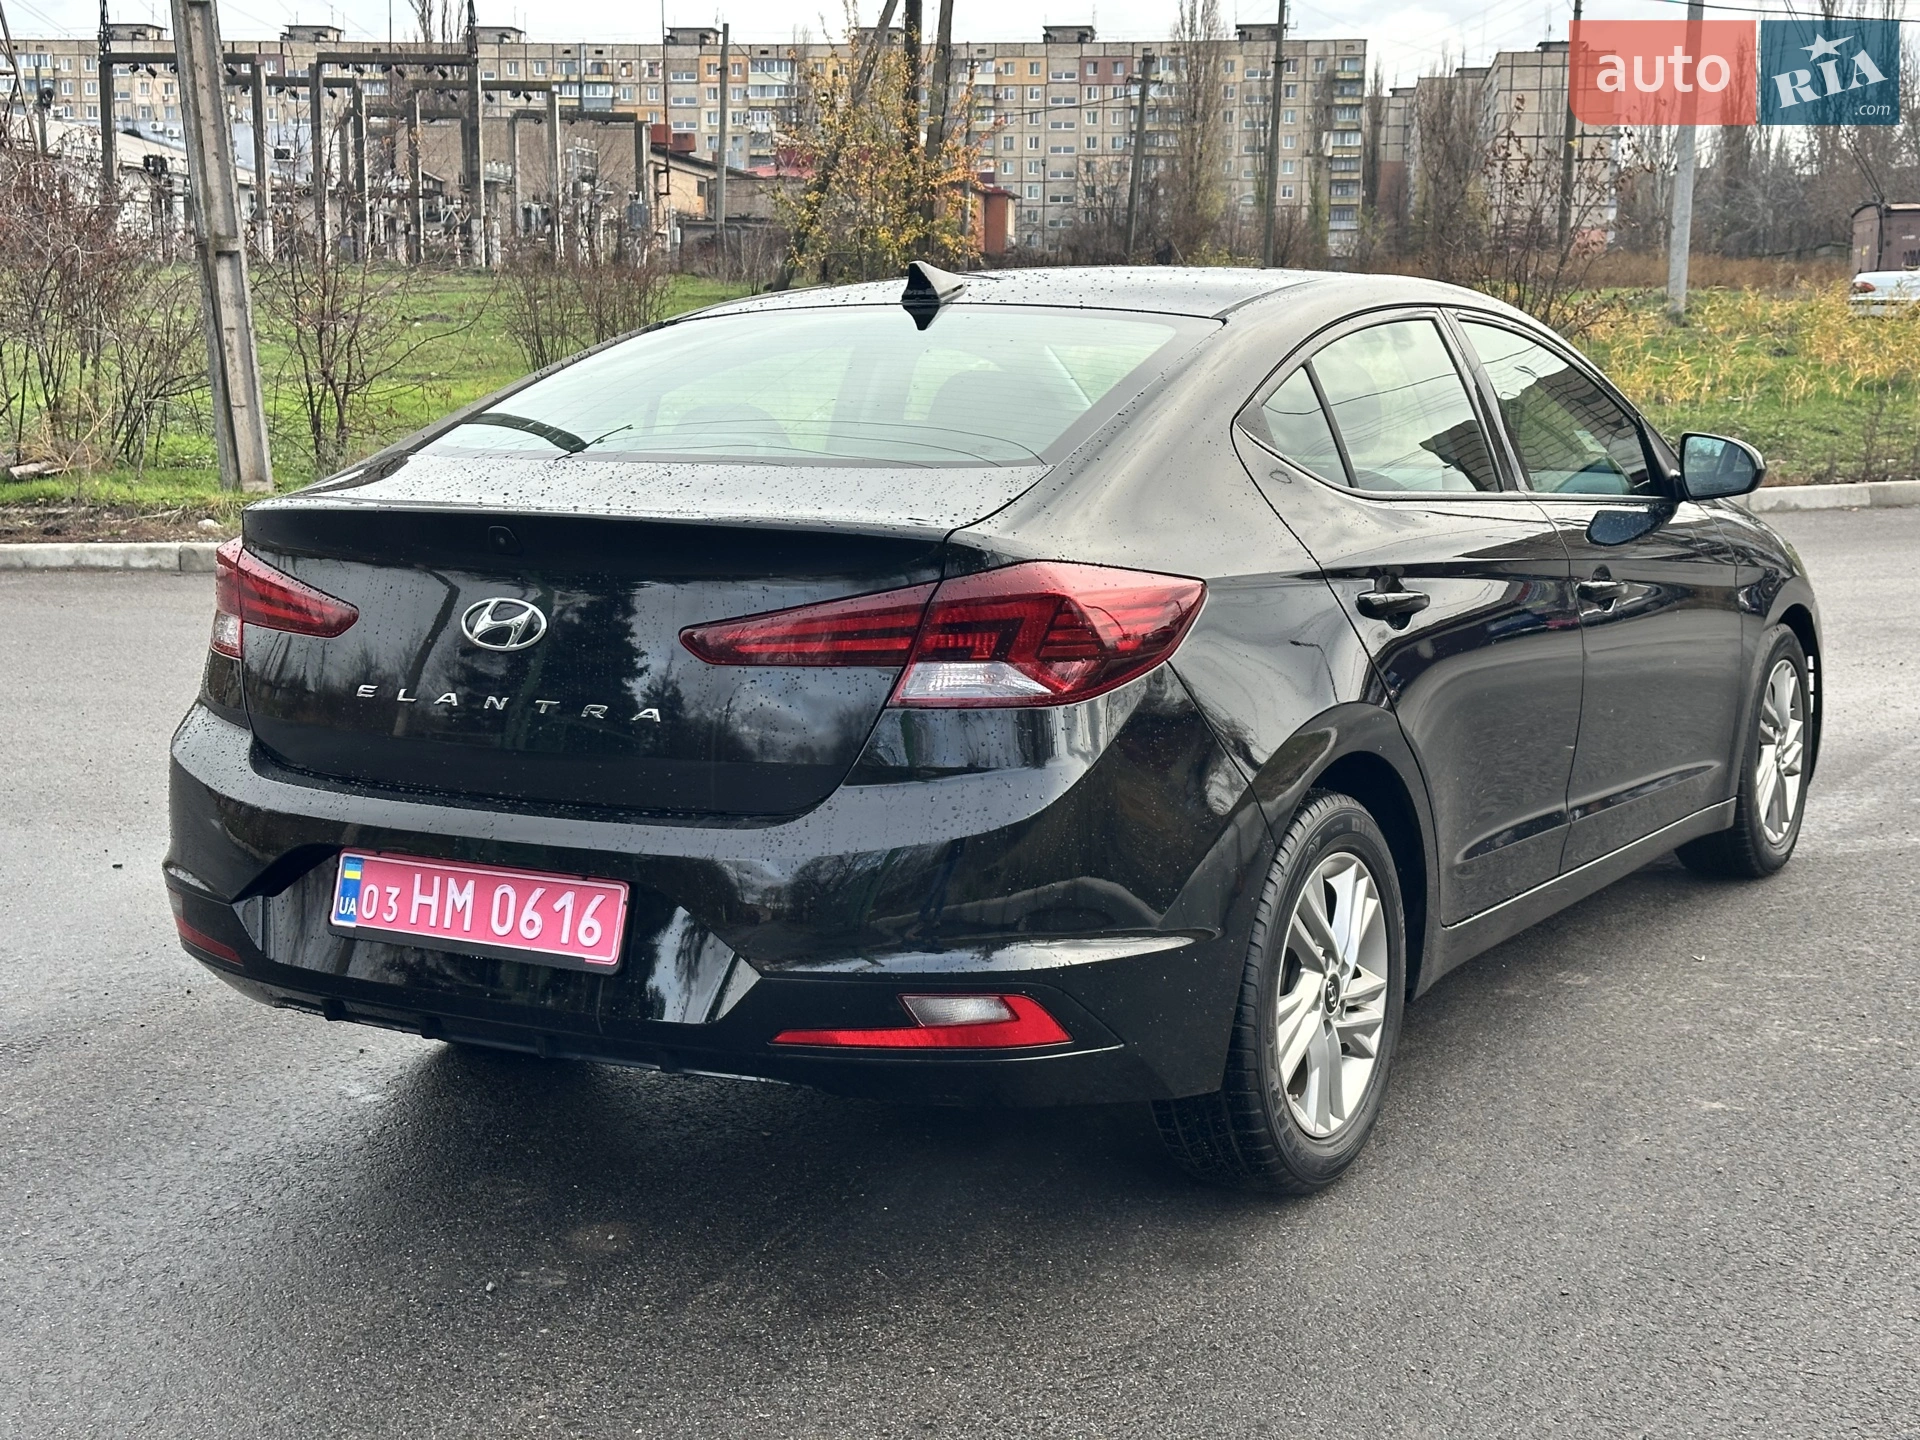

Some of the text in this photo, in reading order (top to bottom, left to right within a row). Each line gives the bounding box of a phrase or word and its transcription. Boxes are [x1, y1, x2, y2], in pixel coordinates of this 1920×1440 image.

[356, 684, 661, 723] ELANTRA
[338, 896, 357, 917] UA
[361, 873, 606, 948] 03 HM 0616
